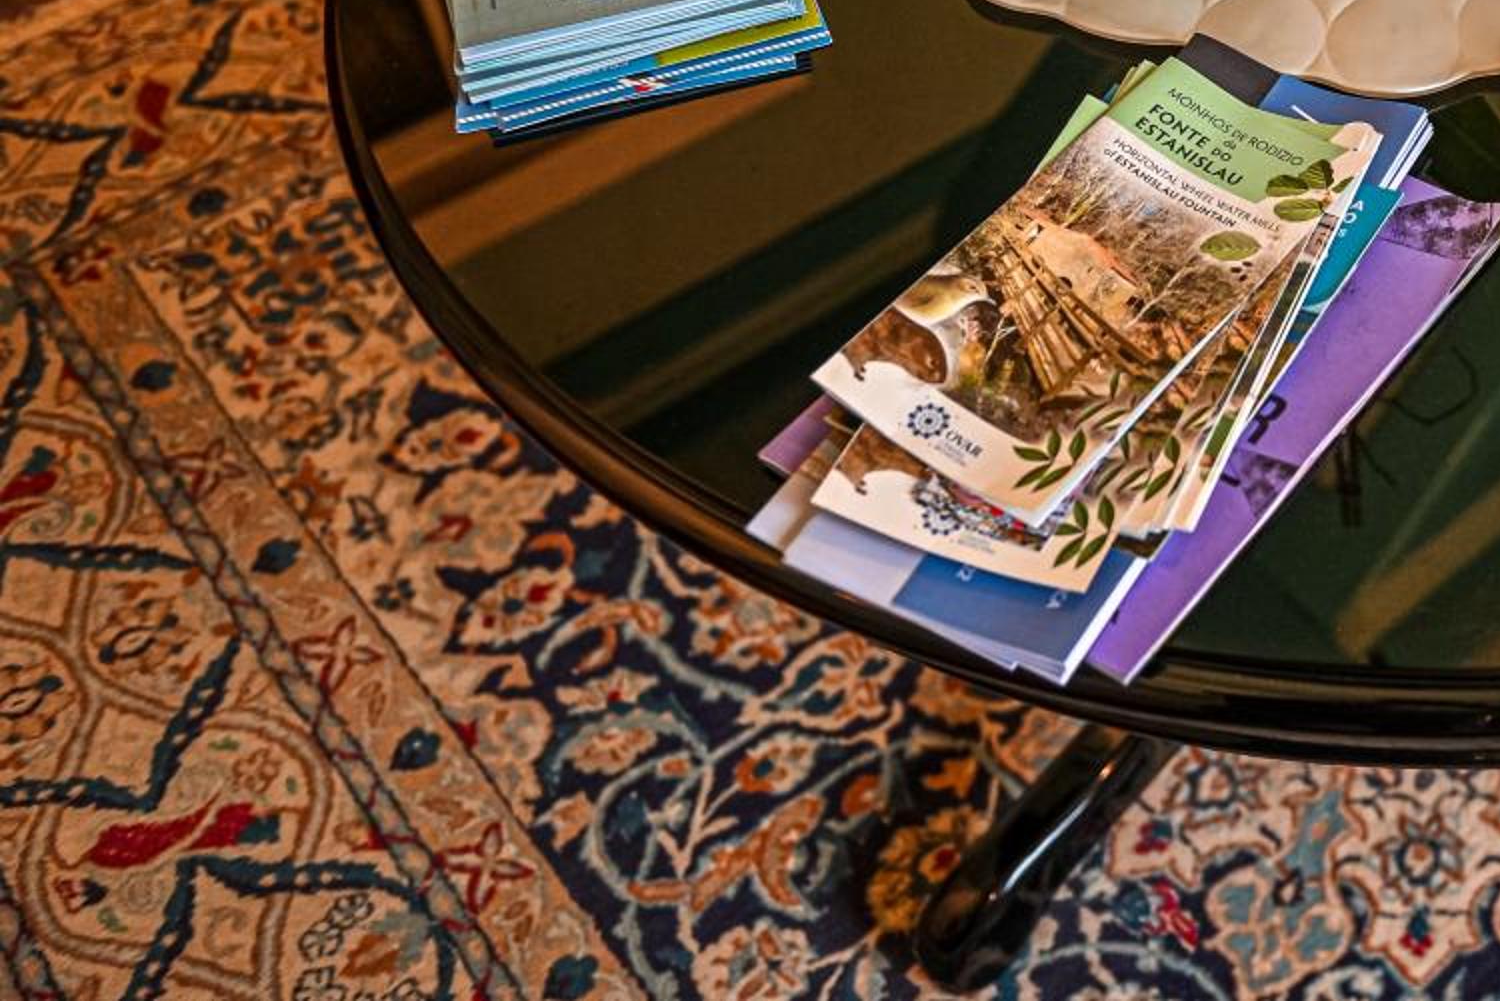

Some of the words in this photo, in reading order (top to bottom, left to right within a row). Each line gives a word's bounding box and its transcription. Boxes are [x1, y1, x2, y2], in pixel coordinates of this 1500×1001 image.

[1149, 103, 1210, 149] FONTE
[1211, 147, 1232, 162] DO
[1168, 86, 1231, 134] MOINHOS
[1113, 137, 1178, 184] HORIZONTAL
[1216, 198, 1249, 223] WATER
[1134, 117, 1244, 187] ESTANISLAU
[1114, 153, 1179, 200] ESTANISLAU
[1178, 195, 1237, 228] FOUNTAIN
